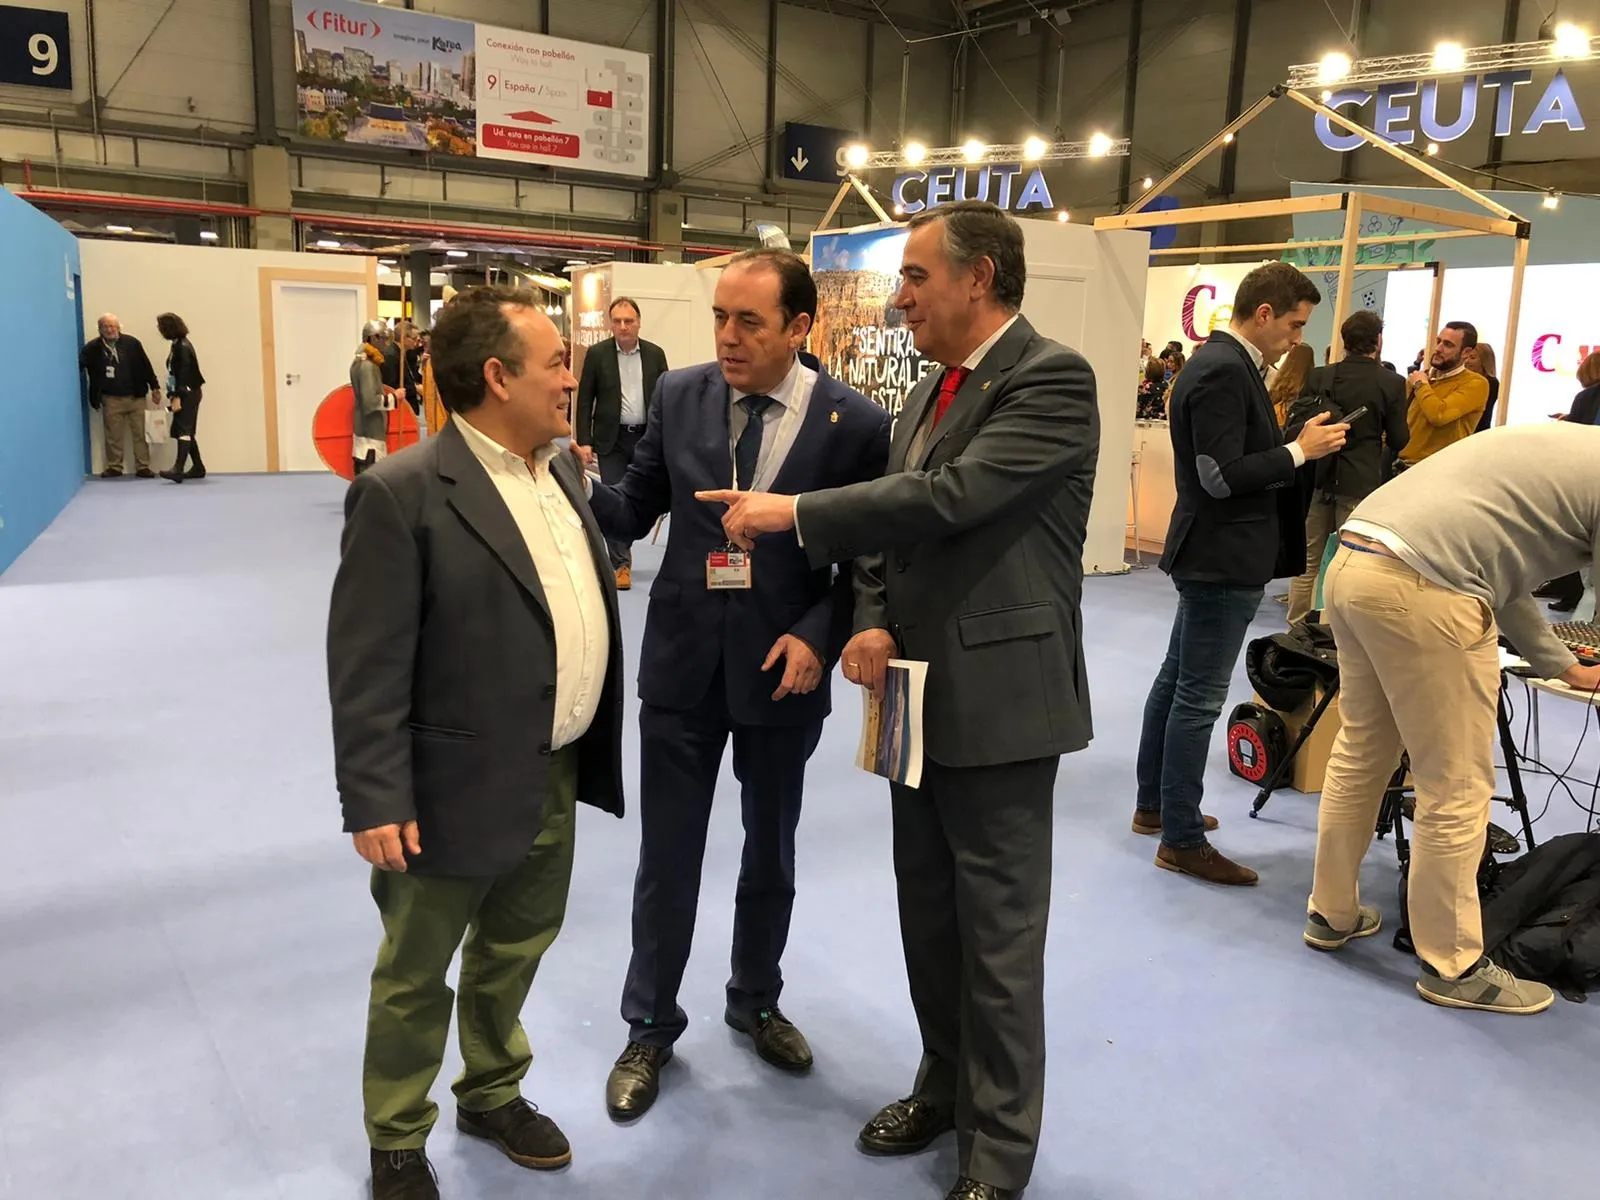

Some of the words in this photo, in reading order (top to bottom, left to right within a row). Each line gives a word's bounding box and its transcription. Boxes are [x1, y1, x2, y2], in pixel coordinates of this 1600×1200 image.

[322, 11, 368, 37] Fitur
[28, 33, 58, 76] 9
[432, 36, 462, 53] Korea
[486, 38, 524, 53] Conexión
[526, 46, 540, 55] con
[542, 49, 576, 61] pabellón
[487, 74, 498, 90] 9
[504, 79, 536, 94] España
[1314, 67, 1586, 152] CEUTA
[493, 127, 506, 137] Ud.
[534, 133, 565, 145] pabellón
[565, 136, 571, 145] 7
[506, 138, 519, 149] You
[540, 143, 552, 153] hall
[552, 144, 559, 153] 7
[891, 163, 1054, 214] CEUTA
[828, 353, 843, 382] LA
[871, 386, 910, 417] ESTA
